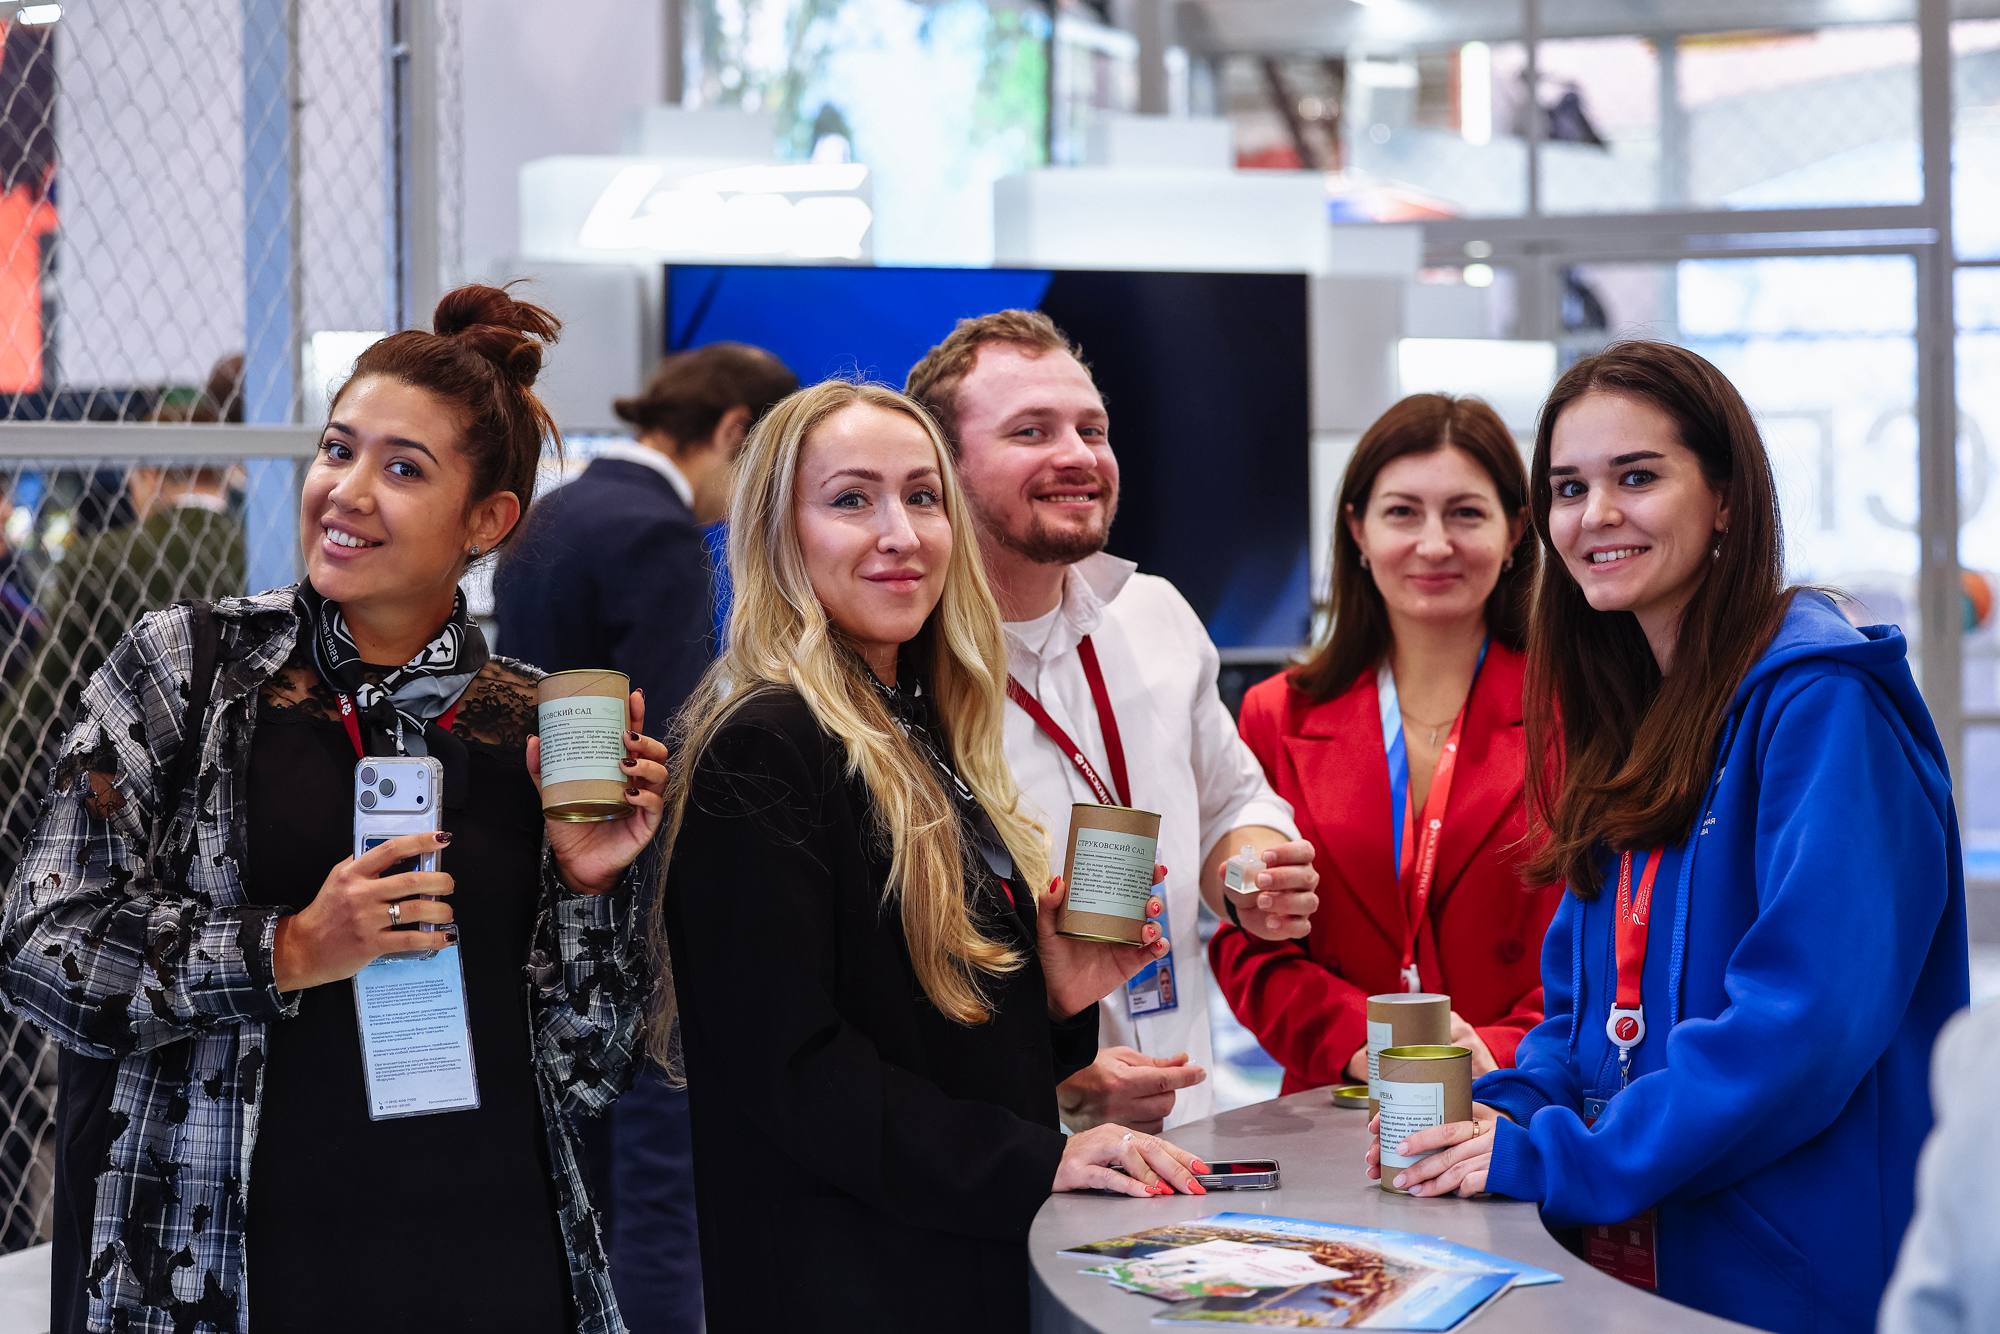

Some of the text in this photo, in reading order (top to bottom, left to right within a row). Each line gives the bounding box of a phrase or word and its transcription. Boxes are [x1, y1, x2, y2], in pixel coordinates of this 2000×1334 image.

[1077, 839, 1145, 855] СТРУКОВСКИЙ САД
[1634, 892, 1643, 912] RUSSIA
